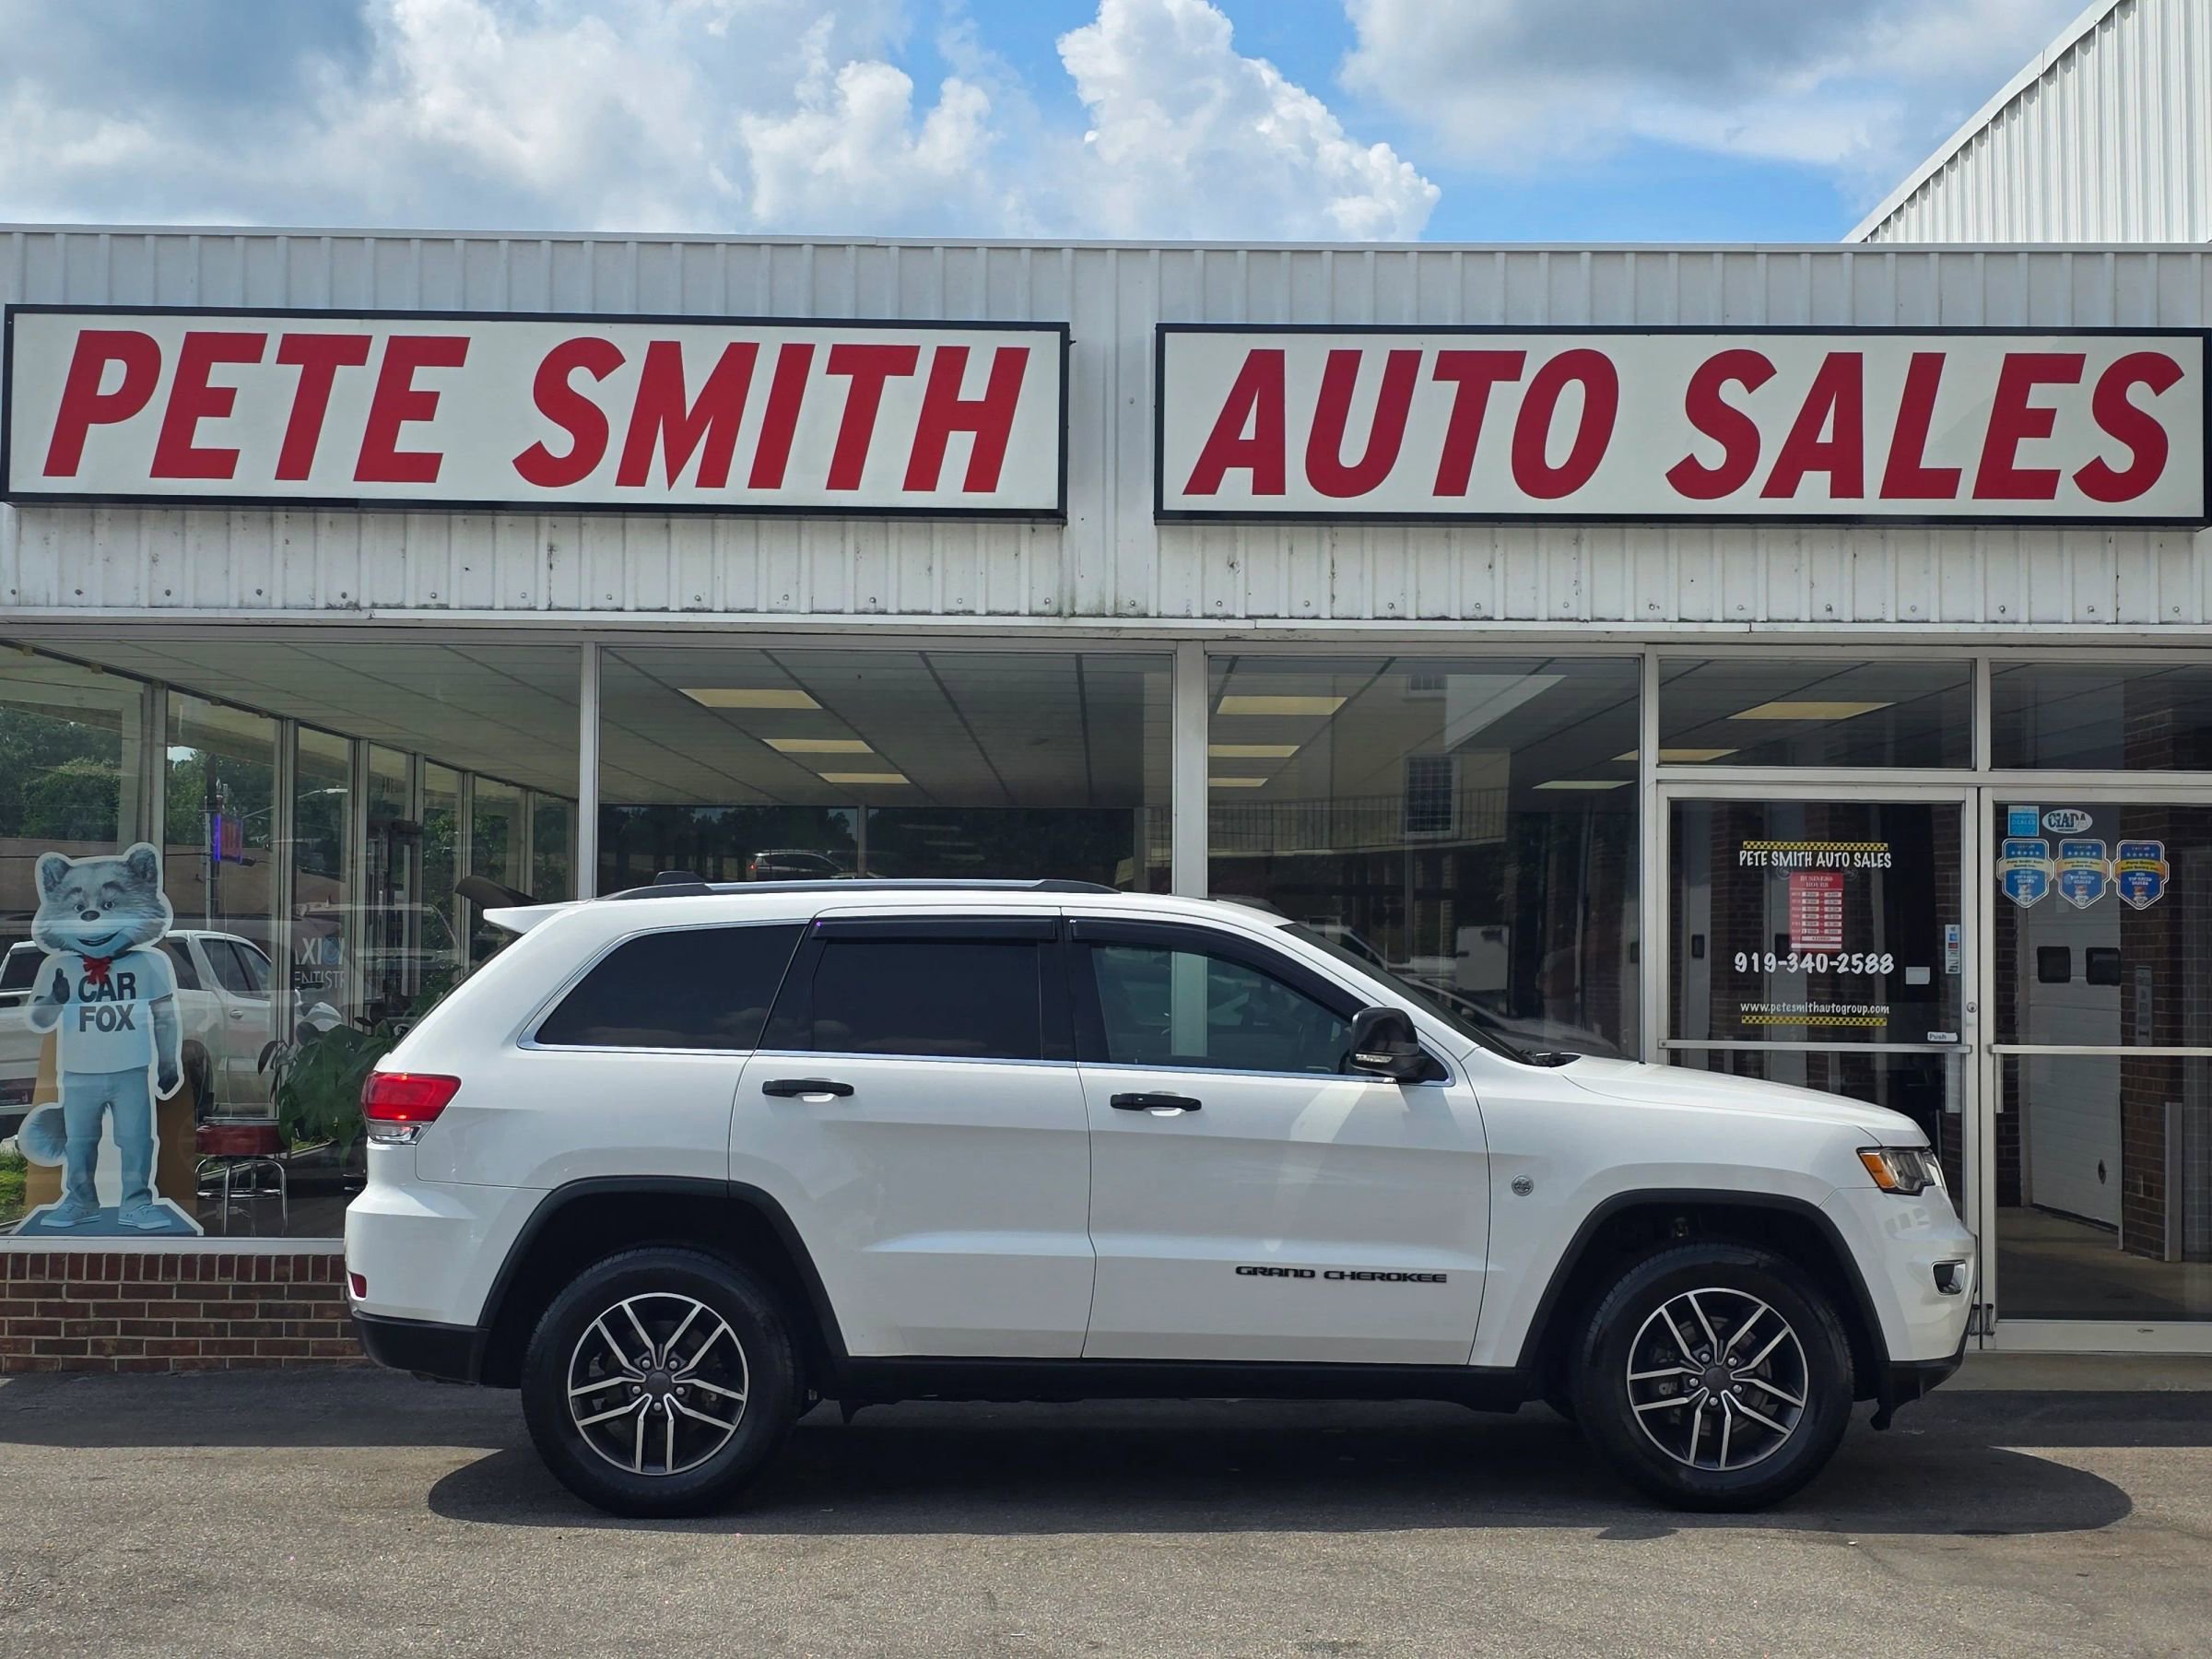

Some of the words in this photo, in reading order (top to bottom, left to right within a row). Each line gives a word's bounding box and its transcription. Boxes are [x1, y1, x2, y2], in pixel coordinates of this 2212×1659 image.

[45, 333, 467, 481] PETE
[516, 338, 1027, 491] SMITH
[1187, 351, 1617, 499] AUTO
[1669, 352, 2179, 501] SALES
[1739, 850, 1768, 866] PETE
[1771, 851, 1813, 867] SMITH
[1816, 852, 1851, 867] AUTO
[1853, 852, 1892, 868] SALES
[1735, 952, 1895, 975] 919-340-2588
[78, 972, 136, 1003] CAR
[79, 1004, 136, 1032] FOX
[1740, 1002, 1890, 1016] www.petesmithautogroup.com
[1235, 1265, 1316, 1279] GRAND
[1324, 1269, 1448, 1283] CHEROKEE
